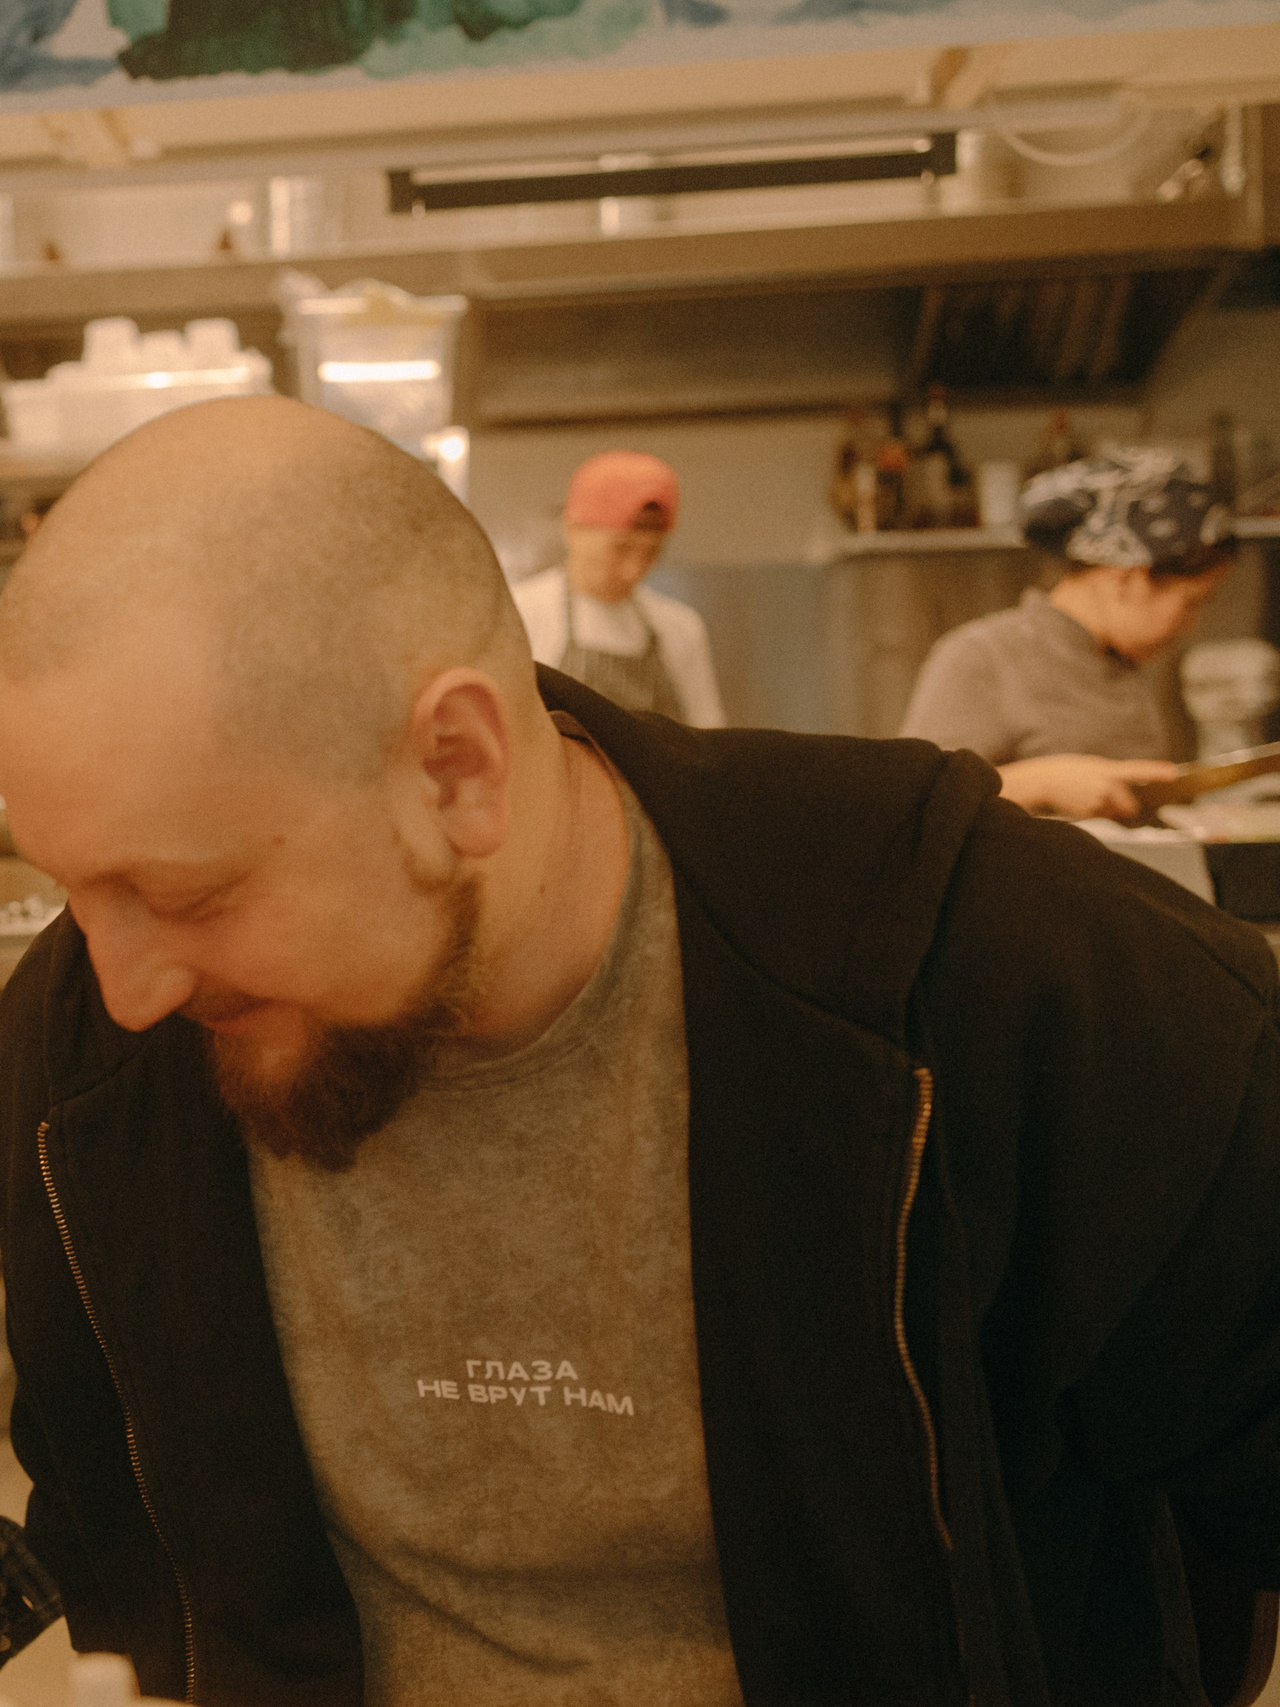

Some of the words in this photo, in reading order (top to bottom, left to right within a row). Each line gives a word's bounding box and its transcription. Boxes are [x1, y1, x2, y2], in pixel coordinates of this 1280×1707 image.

[466, 1359, 578, 1381] ГЛАЗА
[417, 1379, 460, 1400] НЕ
[467, 1384, 552, 1406] ВРУТ
[563, 1386, 634, 1416] НАМ
